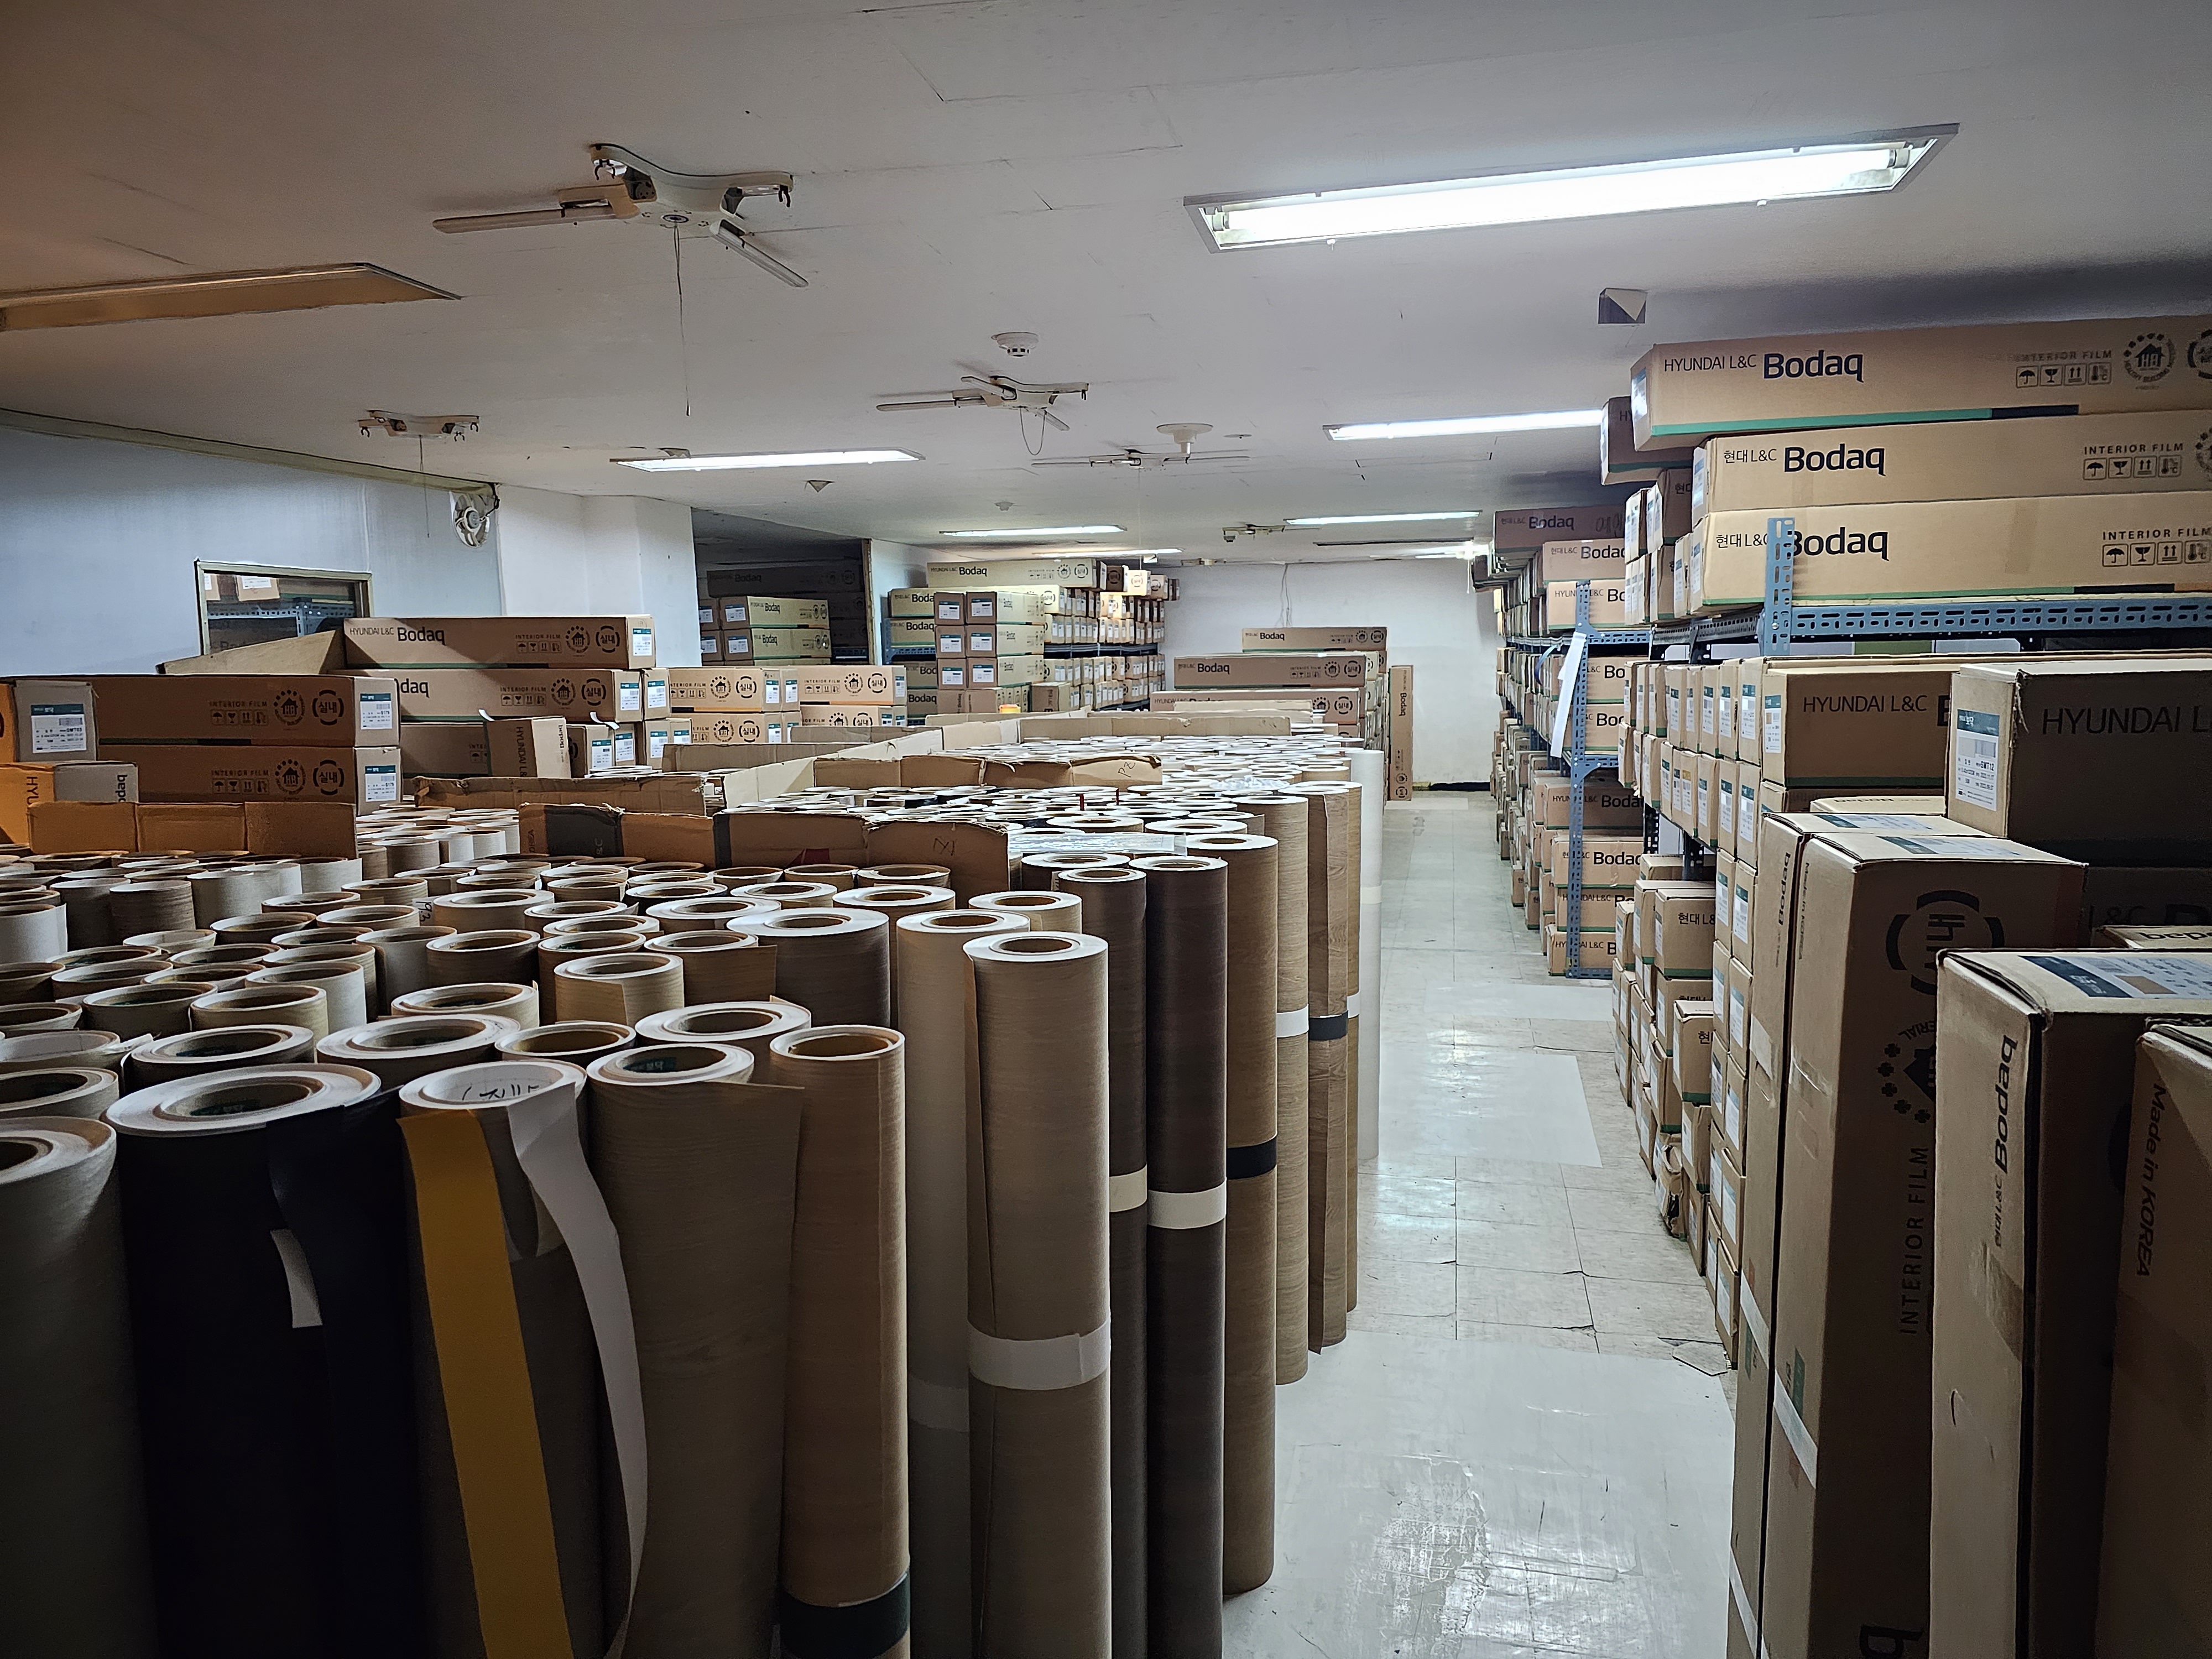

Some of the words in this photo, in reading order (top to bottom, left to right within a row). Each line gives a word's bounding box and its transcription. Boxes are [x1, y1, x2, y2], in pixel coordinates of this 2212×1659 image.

[2082, 349, 2112, 359] FILM
[1664, 355, 1724, 372] HYUNDAI
[1729, 354, 1757, 369] L&C
[1763, 349, 1864, 383] Bodaq
[2084, 444, 2146, 455] INTERIOR
[2152, 443, 2184, 452] FILM
[1723, 449, 1748, 464] 현대
[1750, 448, 1777, 462] L&C
[1784, 443, 1886, 477] Bodaq
[1529, 515, 1575, 531] Bodaq
[1716, 534, 1742, 549] 현대
[2103, 529, 2171, 540] INTERIOR
[2178, 528, 2212, 537] FILM
[959, 566, 988, 577] Bodaq
[912, 594, 935, 603] Boda
[765, 603, 780, 614] Bodaq
[349, 627, 379, 635] HYUNDAI
[381, 627, 394, 635] L&C
[397, 626, 446, 646] Bodaq
[1260, 632, 1285, 641] Bodaq
[1197, 662, 1230, 675] Bodaq
[400, 678, 430, 698] daq
[908, 694, 937, 705] Bodaq
[1399, 692, 1407, 717] Bodaq
[1803, 695, 1884, 713] HYUNDAI
[1891, 695, 1928, 712] L&C
[2042, 706, 2181, 735] HYUNDAI
[1601, 794, 1644, 808] Boda
[1678, 912, 1700, 925] 현대
[1702, 914, 1715, 925] L&
[1589, 941, 1604, 949] L&C
[1995, 1035, 2018, 1174] Bodaq
[2145, 1083, 2167, 1154] Made
[1908, 1147, 1929, 1204] FILM
[2141, 1157, 2159, 1181] in
[2136, 1185, 2157, 1276] KOREA
[1900, 1216, 1924, 1335] INTERIOR
